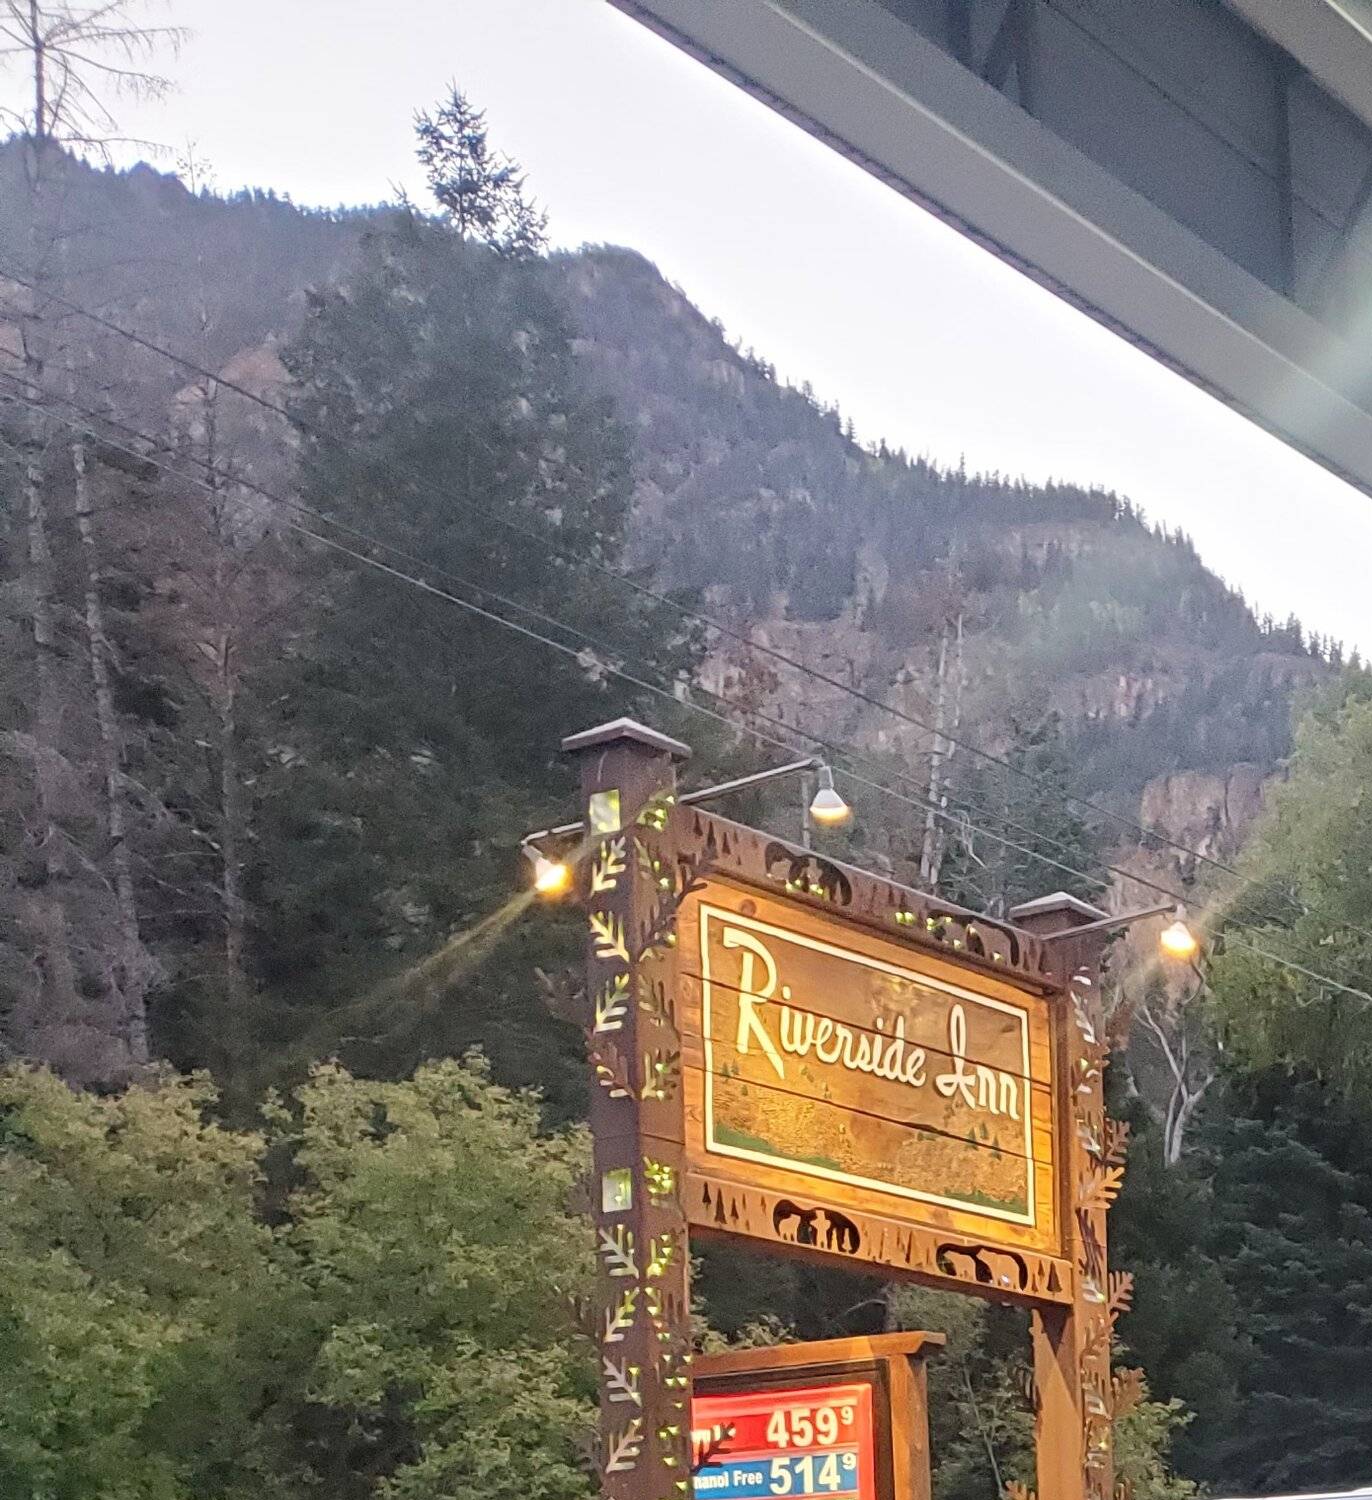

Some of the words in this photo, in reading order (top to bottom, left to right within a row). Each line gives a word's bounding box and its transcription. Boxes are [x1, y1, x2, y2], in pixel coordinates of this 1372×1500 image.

[723, 926, 927, 1088] Riverside
[936, 1003, 1020, 1121] Inn
[733, 1470, 763, 1486] Free
